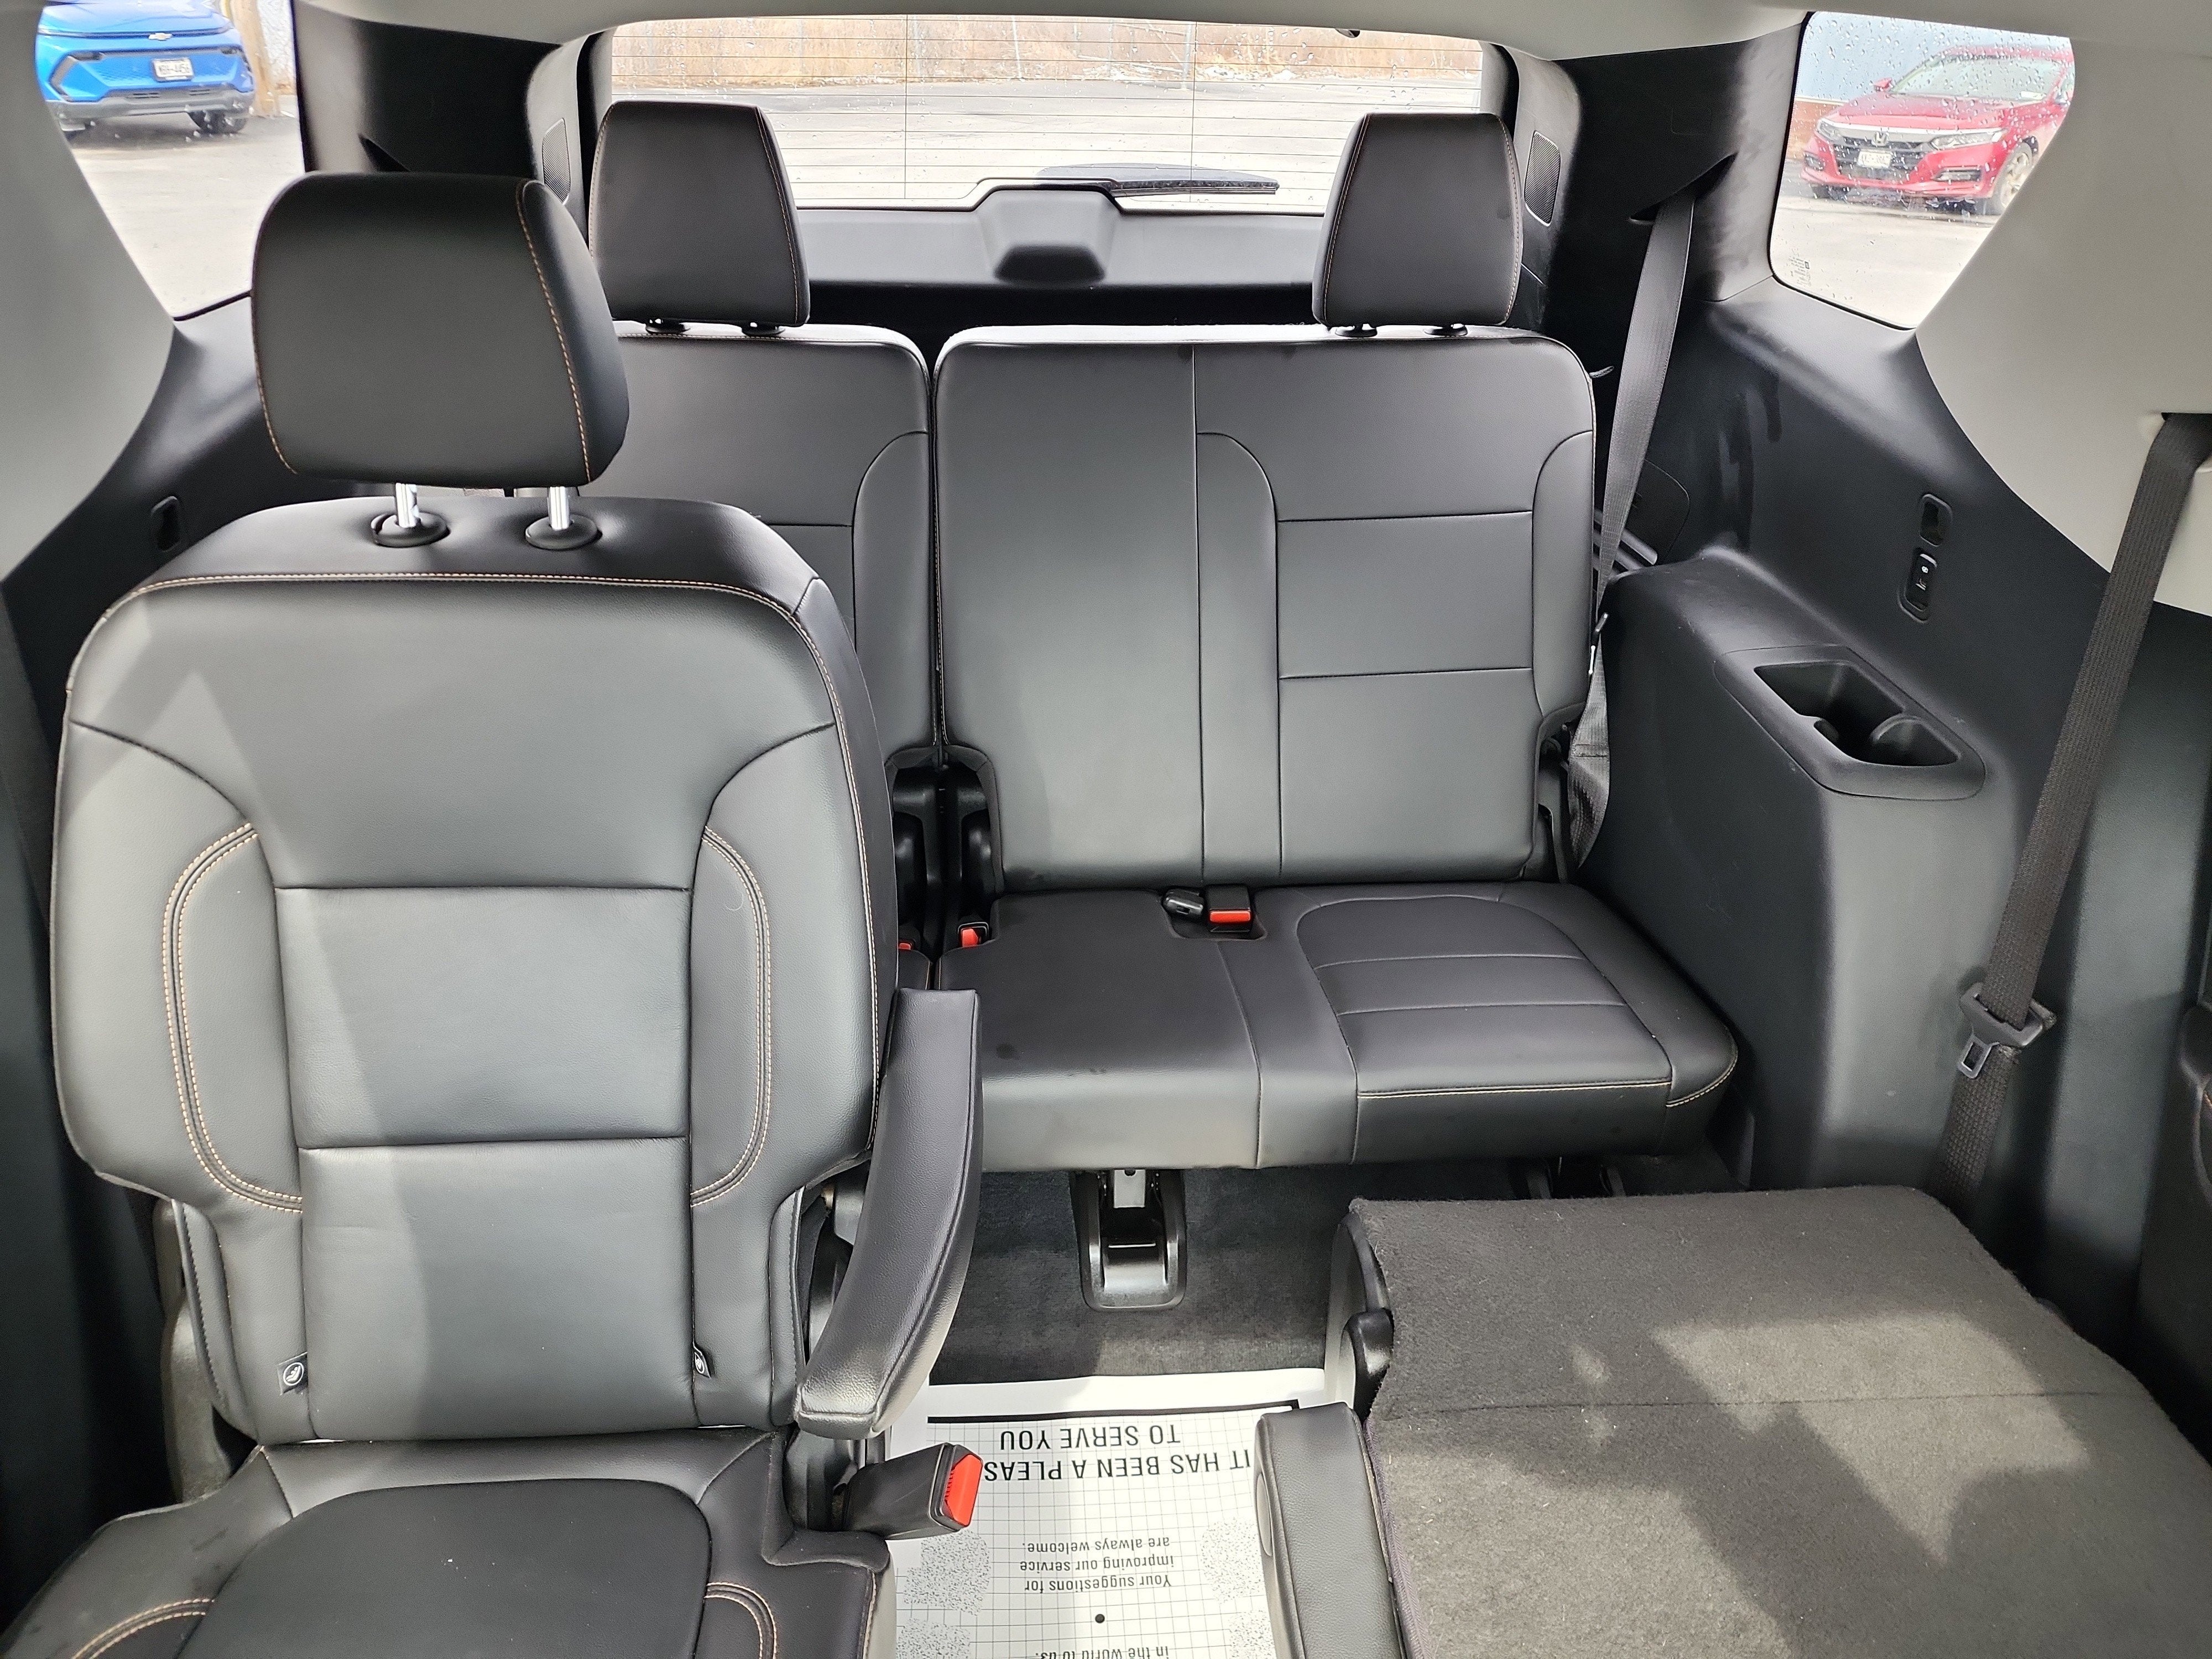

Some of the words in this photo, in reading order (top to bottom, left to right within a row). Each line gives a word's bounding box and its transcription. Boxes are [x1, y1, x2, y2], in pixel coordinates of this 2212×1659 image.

[1000, 1431, 1050, 1450] YOU
[1060, 1426, 1138, 1449] SERVE
[1149, 1425, 1180, 1444] TO
[1097, 1456, 1159, 1478] BEEN
[1170, 1453, 1218, 1474] HAS
[1229, 1449, 1251, 1470] IT
[984, 1460, 1062, 1481] PLEAS
[1071, 1460, 1087, 1478] A
[1022, 1542, 1089, 1554] welcome.
[1095, 1538, 1142, 1551] always
[1149, 1537, 1170, 1547] are
[1020, 1561, 1071, 1573] service
[1076, 1559, 1098, 1572] our
[1103, 1554, 1173, 1569] improving
[1025, 1580, 1044, 1593] for
[1049, 1575, 1134, 1592] suggestions
[1139, 1574, 1171, 1587] Your
[1128, 1647, 1150, 1659] the
[1156, 1646, 1168, 1659] in
